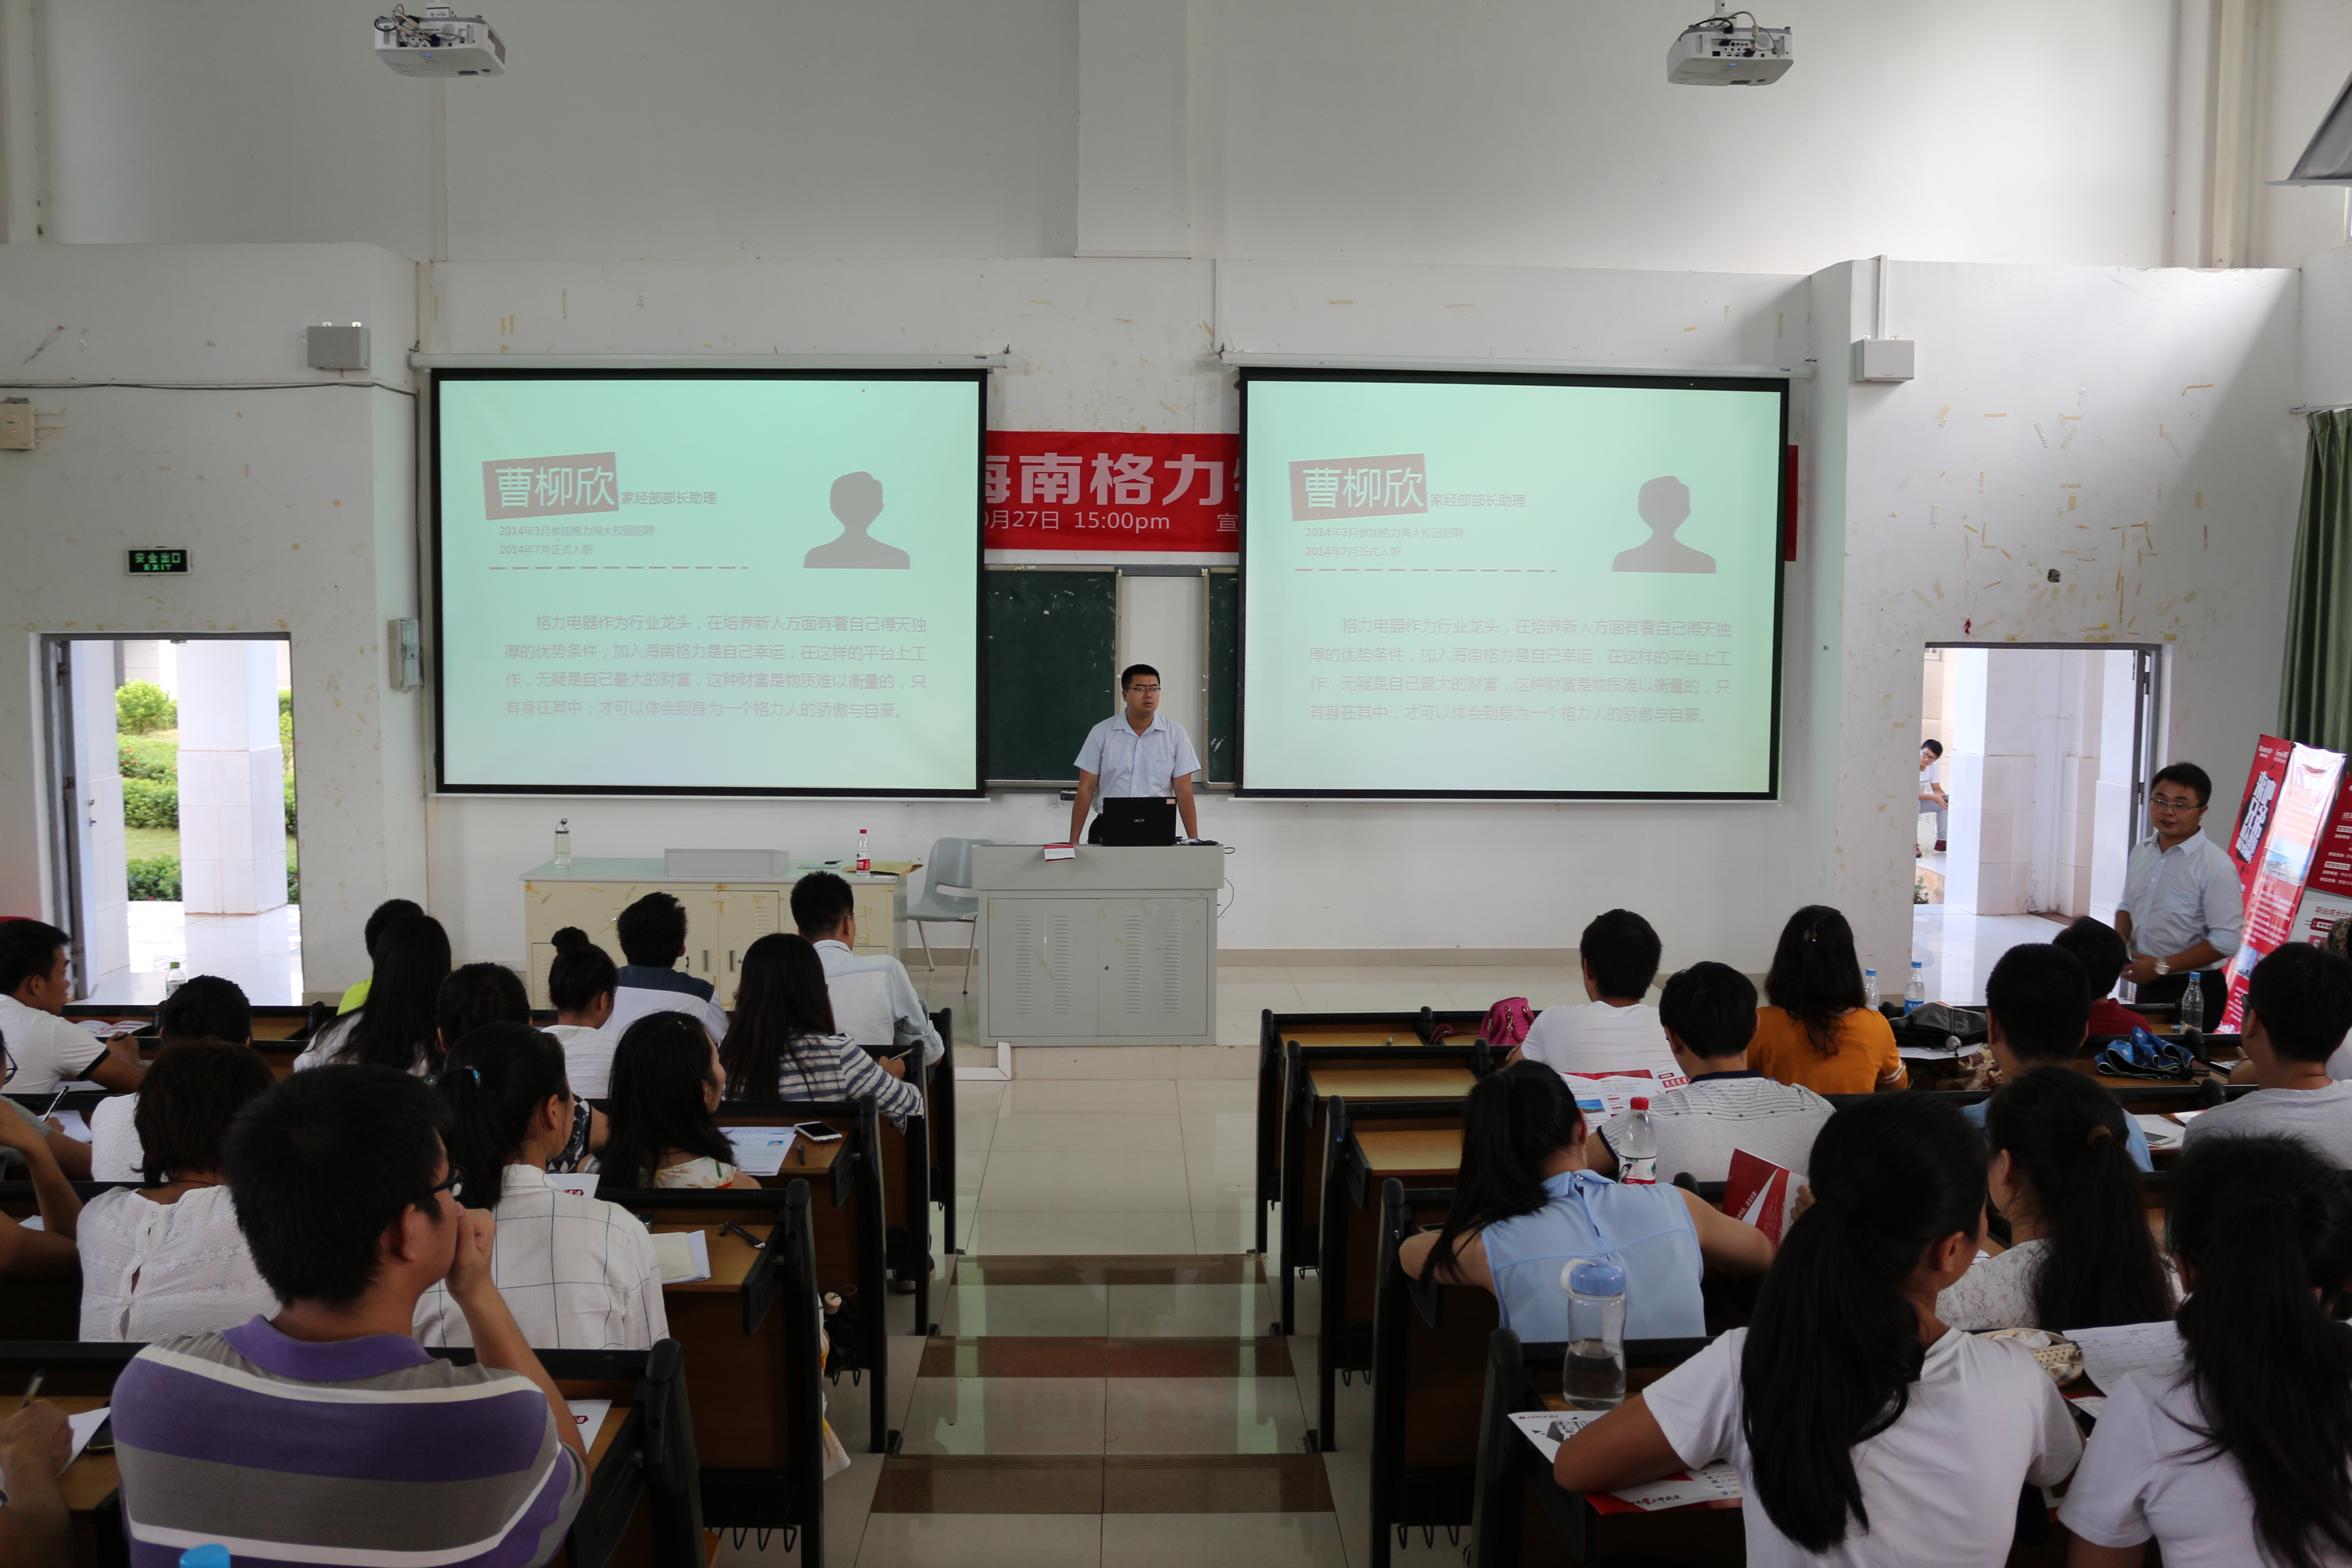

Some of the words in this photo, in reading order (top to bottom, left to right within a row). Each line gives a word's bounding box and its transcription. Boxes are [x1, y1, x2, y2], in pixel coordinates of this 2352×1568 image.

[985, 452, 1239, 505] 南格力
[495, 466, 615, 507] 曹柳欣
[1303, 467, 1424, 508] 曹柳欣
[622, 491, 717, 505] 家经部部长助理
[1430, 493, 1526, 507] 家经部部长助理
[985, 510, 1059, 529] 月27日
[1074, 512, 1170, 533] 15:00pm
[499, 525, 655, 537] 2014年3月参加格力海大校园招聘
[1305, 527, 1464, 538] 2014年3月参加格力海大校园招聘
[499, 544, 593, 555] 2014年7月正式入职
[1305, 546, 1401, 557] 2014年7月正式入职
[135, 553, 181, 563] 安全出口
